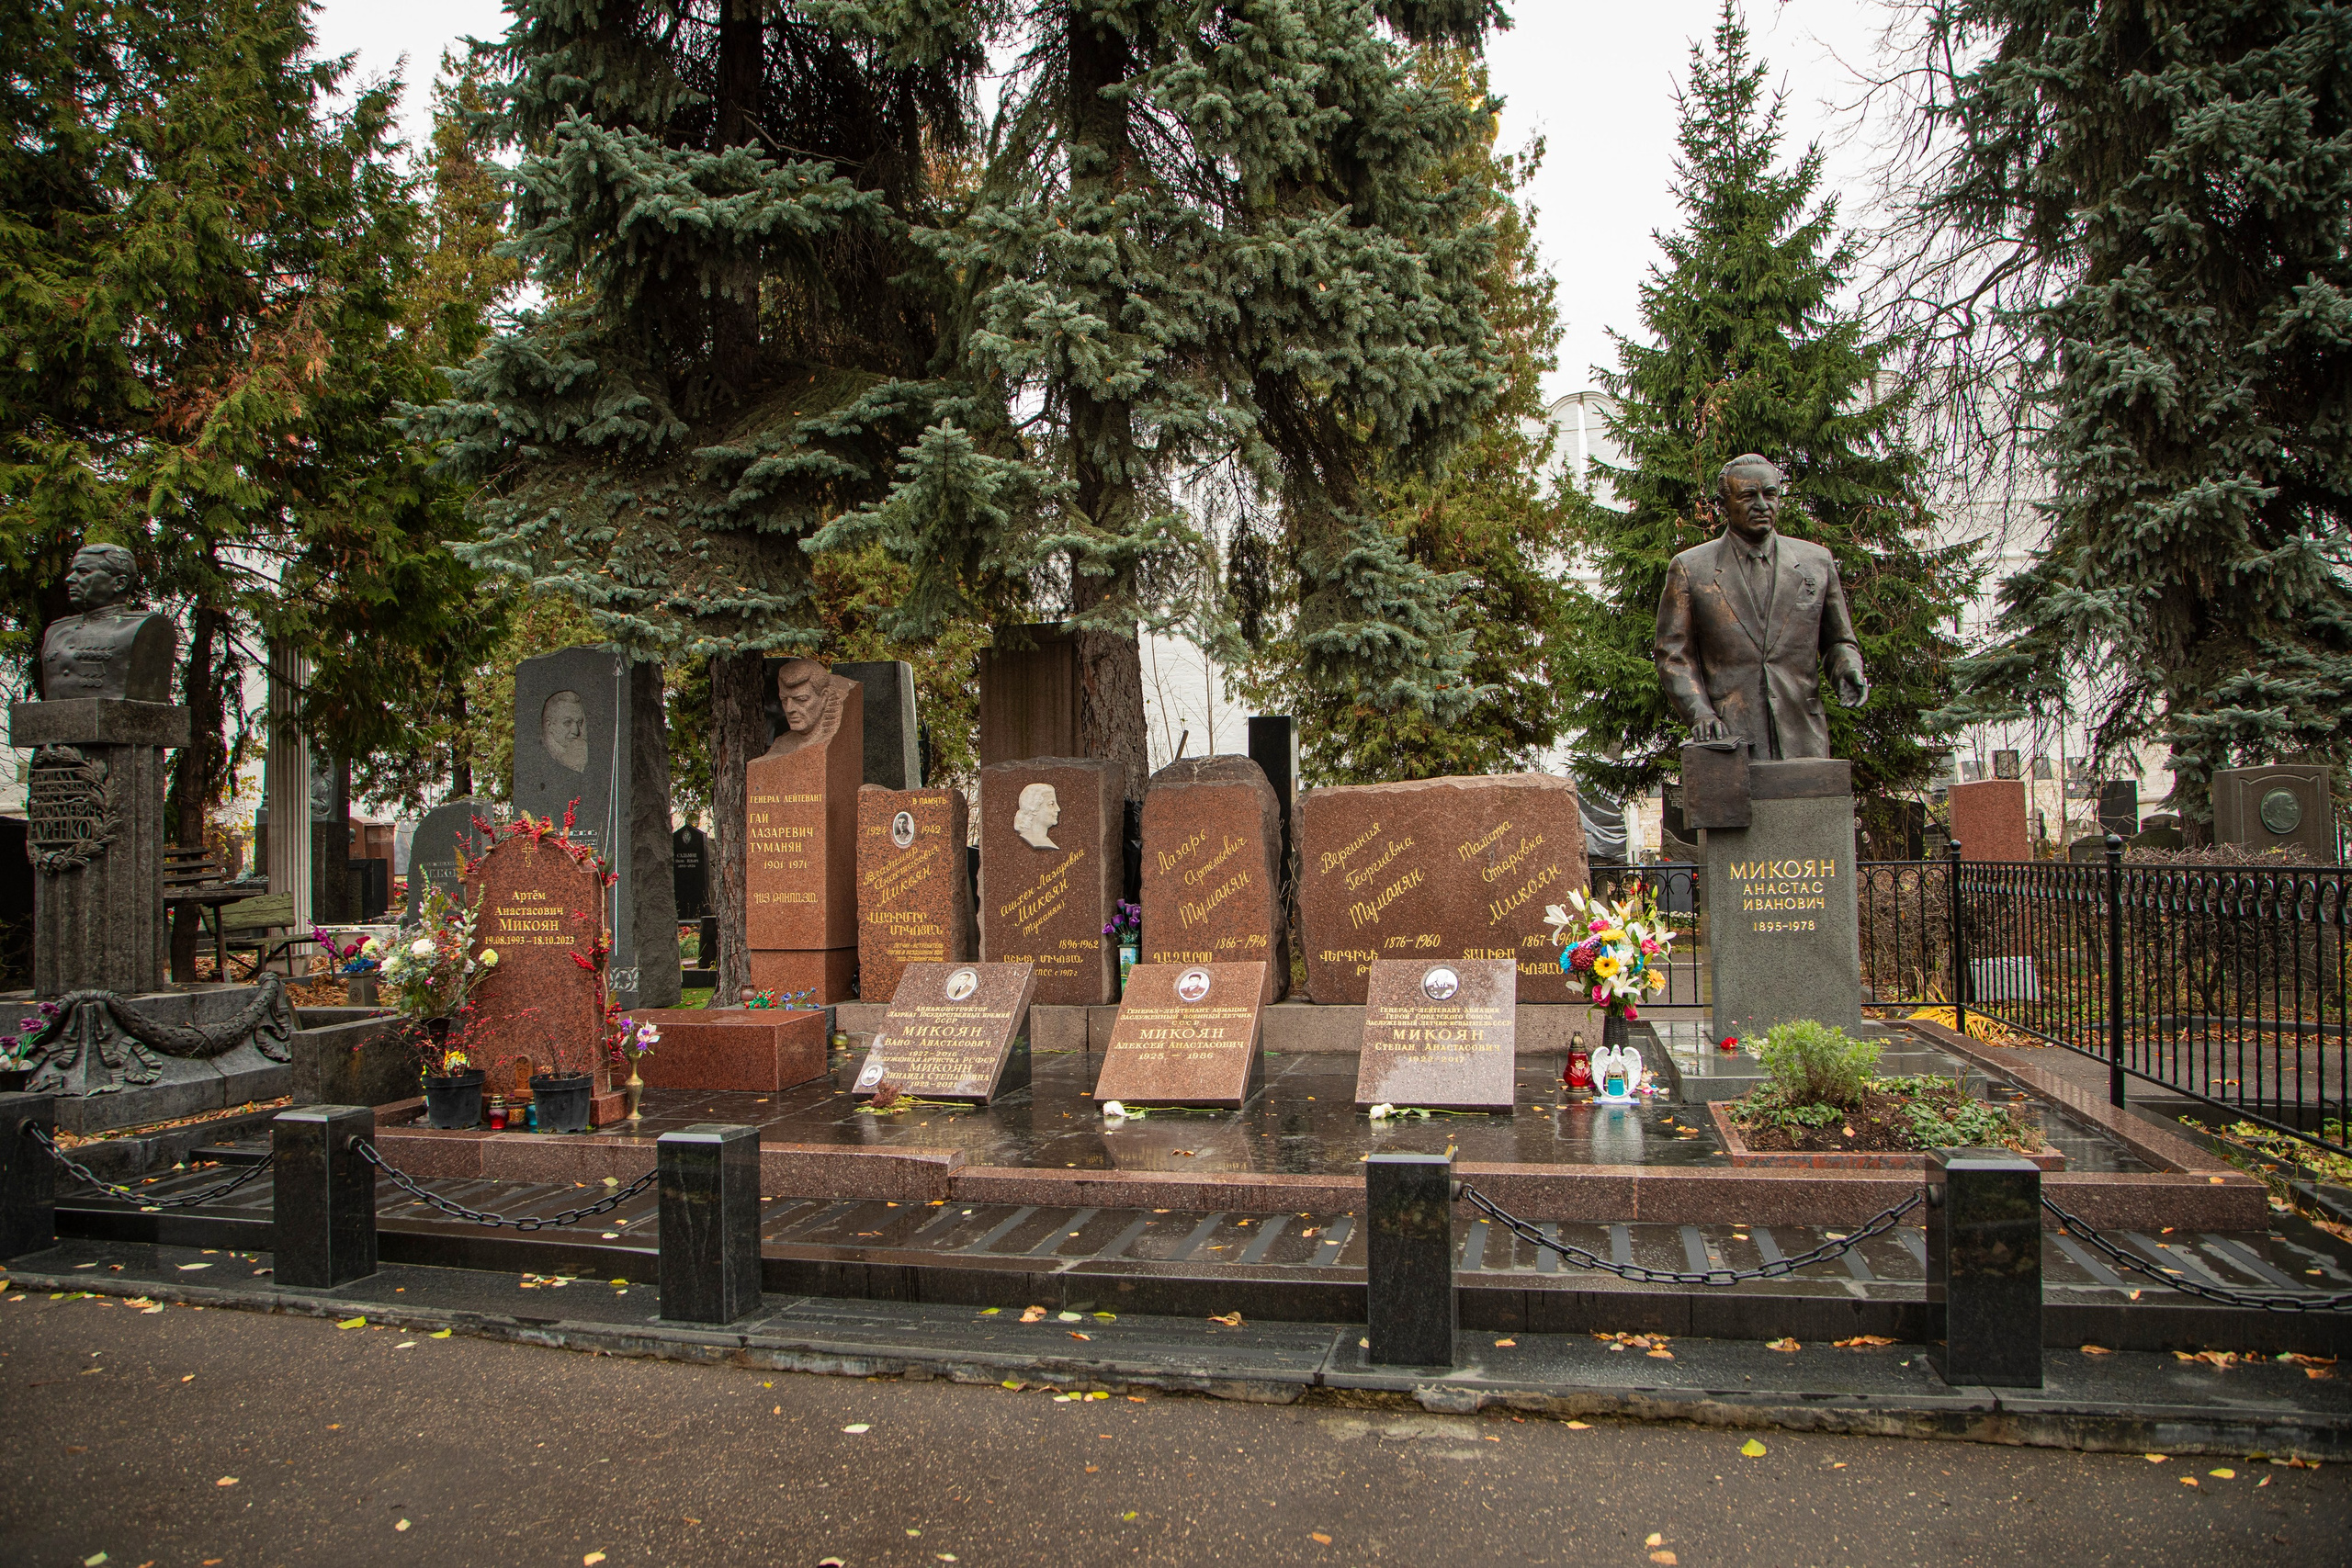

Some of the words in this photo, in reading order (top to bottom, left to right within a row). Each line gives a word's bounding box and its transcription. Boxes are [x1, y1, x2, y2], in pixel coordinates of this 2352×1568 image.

[750, 795, 780, 804] ГЕНЕРАЛ
[784, 794, 823, 803] ЛЕЙТЕНАНТ
[919, 796, 947, 805] ПАМЯТЬ
[750, 810, 769, 824] ГАЙ
[750, 827, 814, 839] ЛАЗАРЕВИЧ
[866, 826, 888, 835] 1924
[921, 825, 941, 834] 1942
[750, 841, 802, 852] ТУМАНЯН
[1158, 829, 1206, 875] Лазарь
[1321, 822, 1382, 874] Вергиния
[1184, 835, 1248, 886] Артемьевич
[1346, 836, 1415, 891] Георгиевна
[1482, 832, 1546, 883] Отаровна
[763, 860, 784, 869] 1901
[789, 860, 808, 869] 1971
[864, 846, 918, 886] Владимир
[874, 845, 940, 890] Анастасович
[1037, 848, 1085, 890] Лазаревна
[1730, 859, 1836, 880] МИКОЯН
[1743, 881, 1824, 896] АНАСТАС
[512, 889, 547, 903] Артём
[1743, 897, 1826, 911] ИВАНОВИЧ
[494, 907, 564, 916] Анастасович
[1753, 920, 1815, 932] 1895-1978
[484, 936, 525, 945] 19.08.1993
[533, 936, 575, 945] 18.10.2023
[902, 1026, 983, 1037] МИКОЯН
[1139, 1028, 1225, 1040] МИКОЯН
[1393, 1029, 1485, 1041] МИКОЯН
[1138, 1052, 1165, 1060] 1925
[909, 1063, 973, 1073] МИКОЯН
